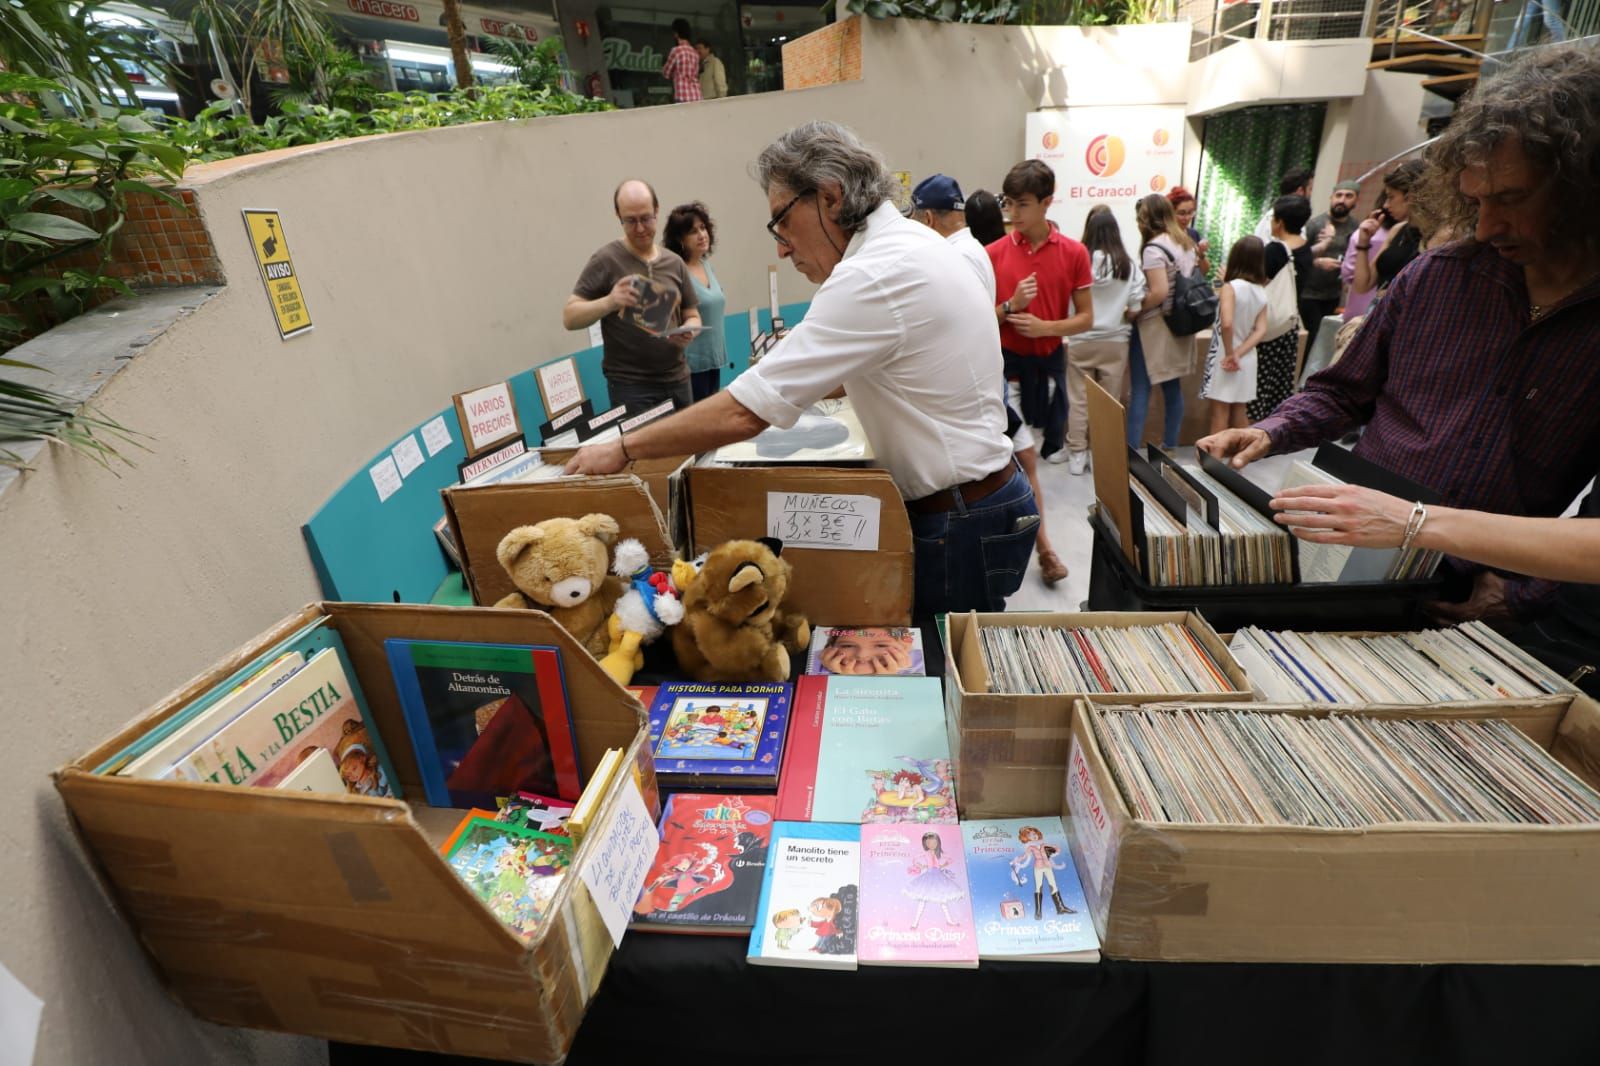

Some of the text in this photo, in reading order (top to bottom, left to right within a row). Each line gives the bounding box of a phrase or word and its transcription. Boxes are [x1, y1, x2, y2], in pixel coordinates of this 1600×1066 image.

[1070, 184, 1137, 198] El Caracol
[266, 262, 292, 279] AVISO
[470, 395, 505, 417] VARIOS
[472, 413, 511, 438] PRECIOS
[463, 443, 522, 480] INTERNACIONAL
[784, 494, 858, 512] MUÑECOS
[452, 672, 500, 684] Detrás de
[448, 682, 511, 695] Altamontaña
[719, 685, 742, 693] PARA
[745, 685, 785, 694] DORMIR
[273, 680, 342, 747] BESTIA
[787, 845, 849, 856] Manolito tiene
[801, 855, 834, 864] secreto
[667, 912, 700, 920] castillo
[701, 912, 712, 921] de
[983, 920, 1039, 937] Princesa
